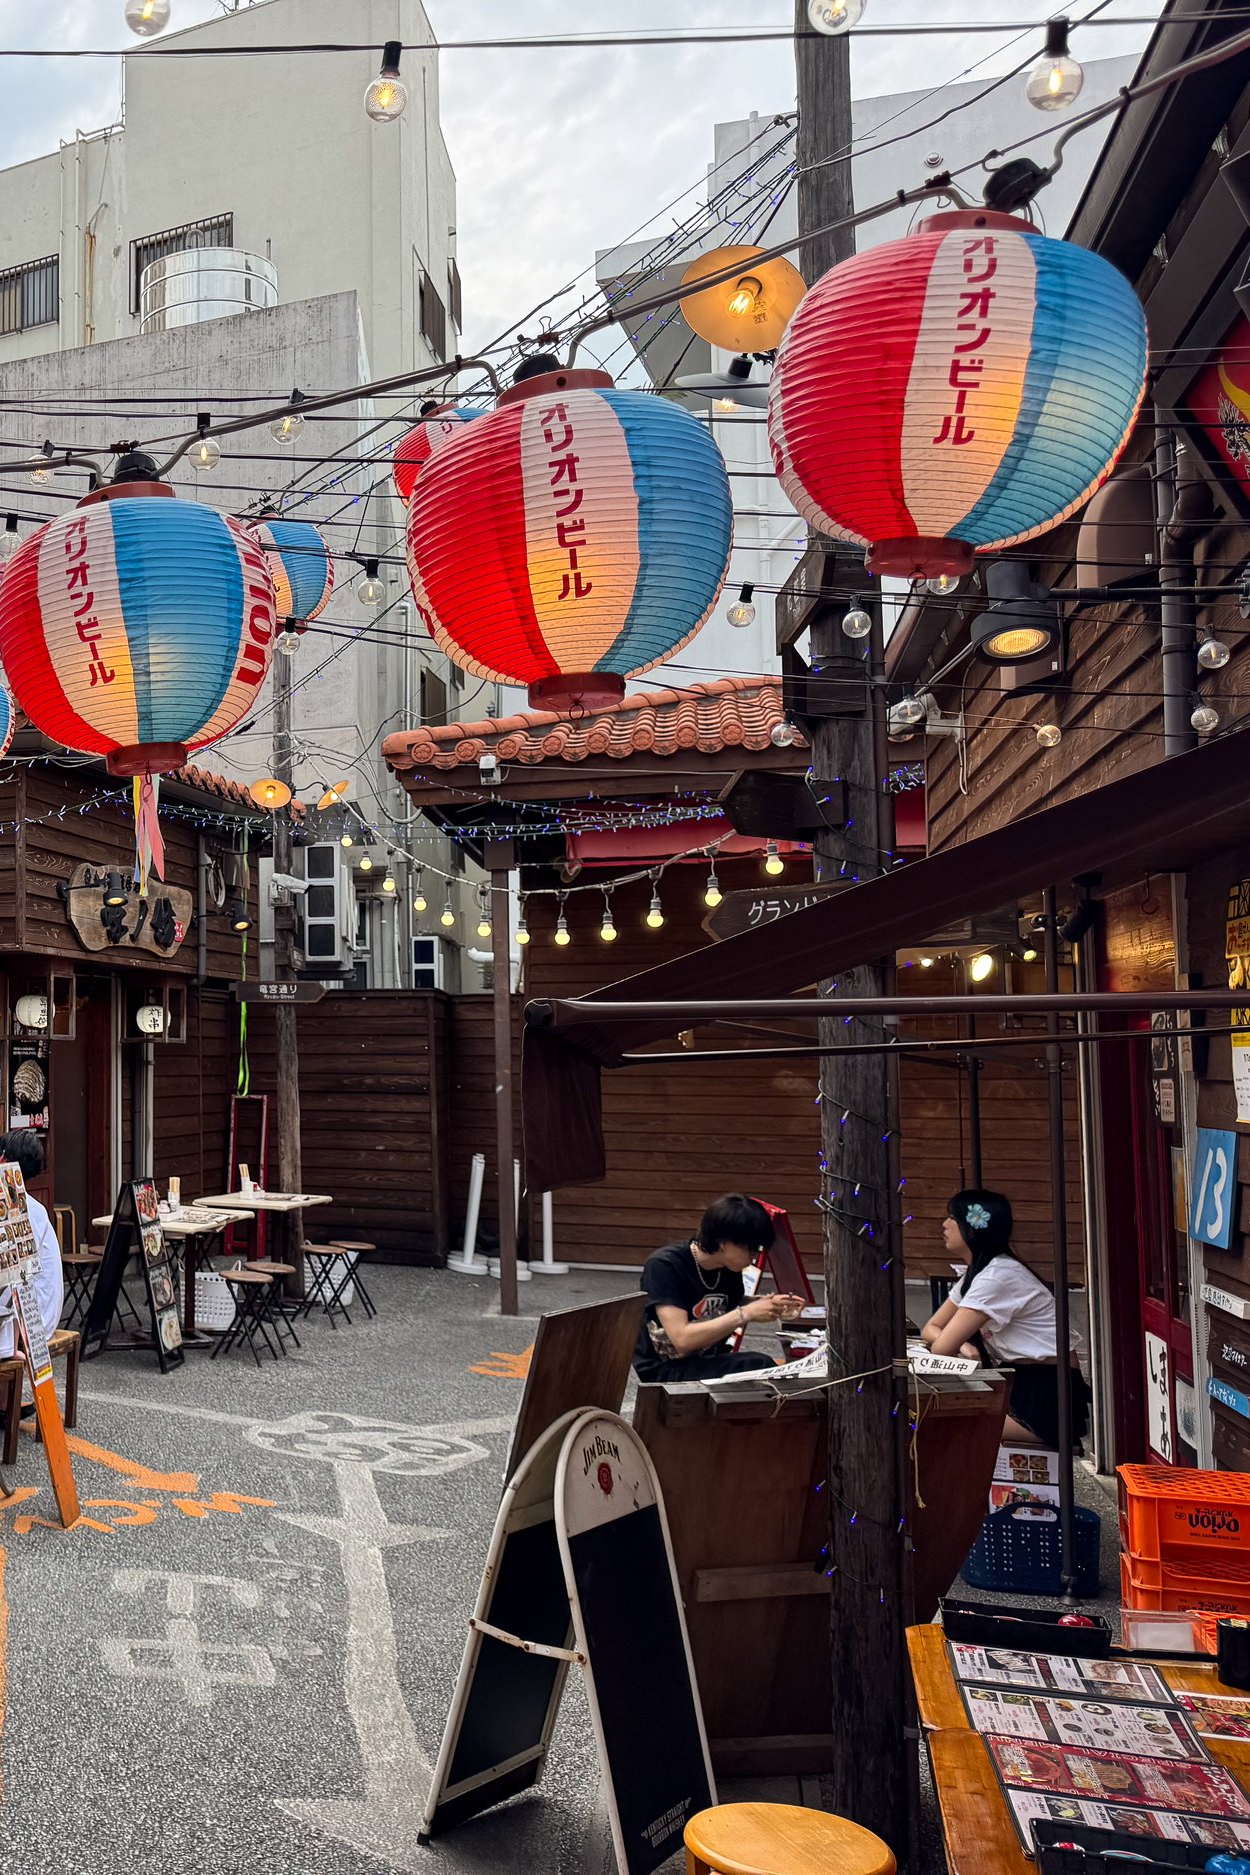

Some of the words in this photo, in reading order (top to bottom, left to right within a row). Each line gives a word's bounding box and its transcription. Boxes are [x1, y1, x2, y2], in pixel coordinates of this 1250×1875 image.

[933, 236, 1000, 446] オリオンビール
[538, 403, 593, 601] オリオンビール
[65, 516, 116, 687] オリオンビール
[583, 1443, 597, 1476] JIM
[595, 1435, 622, 1465] BEAM
